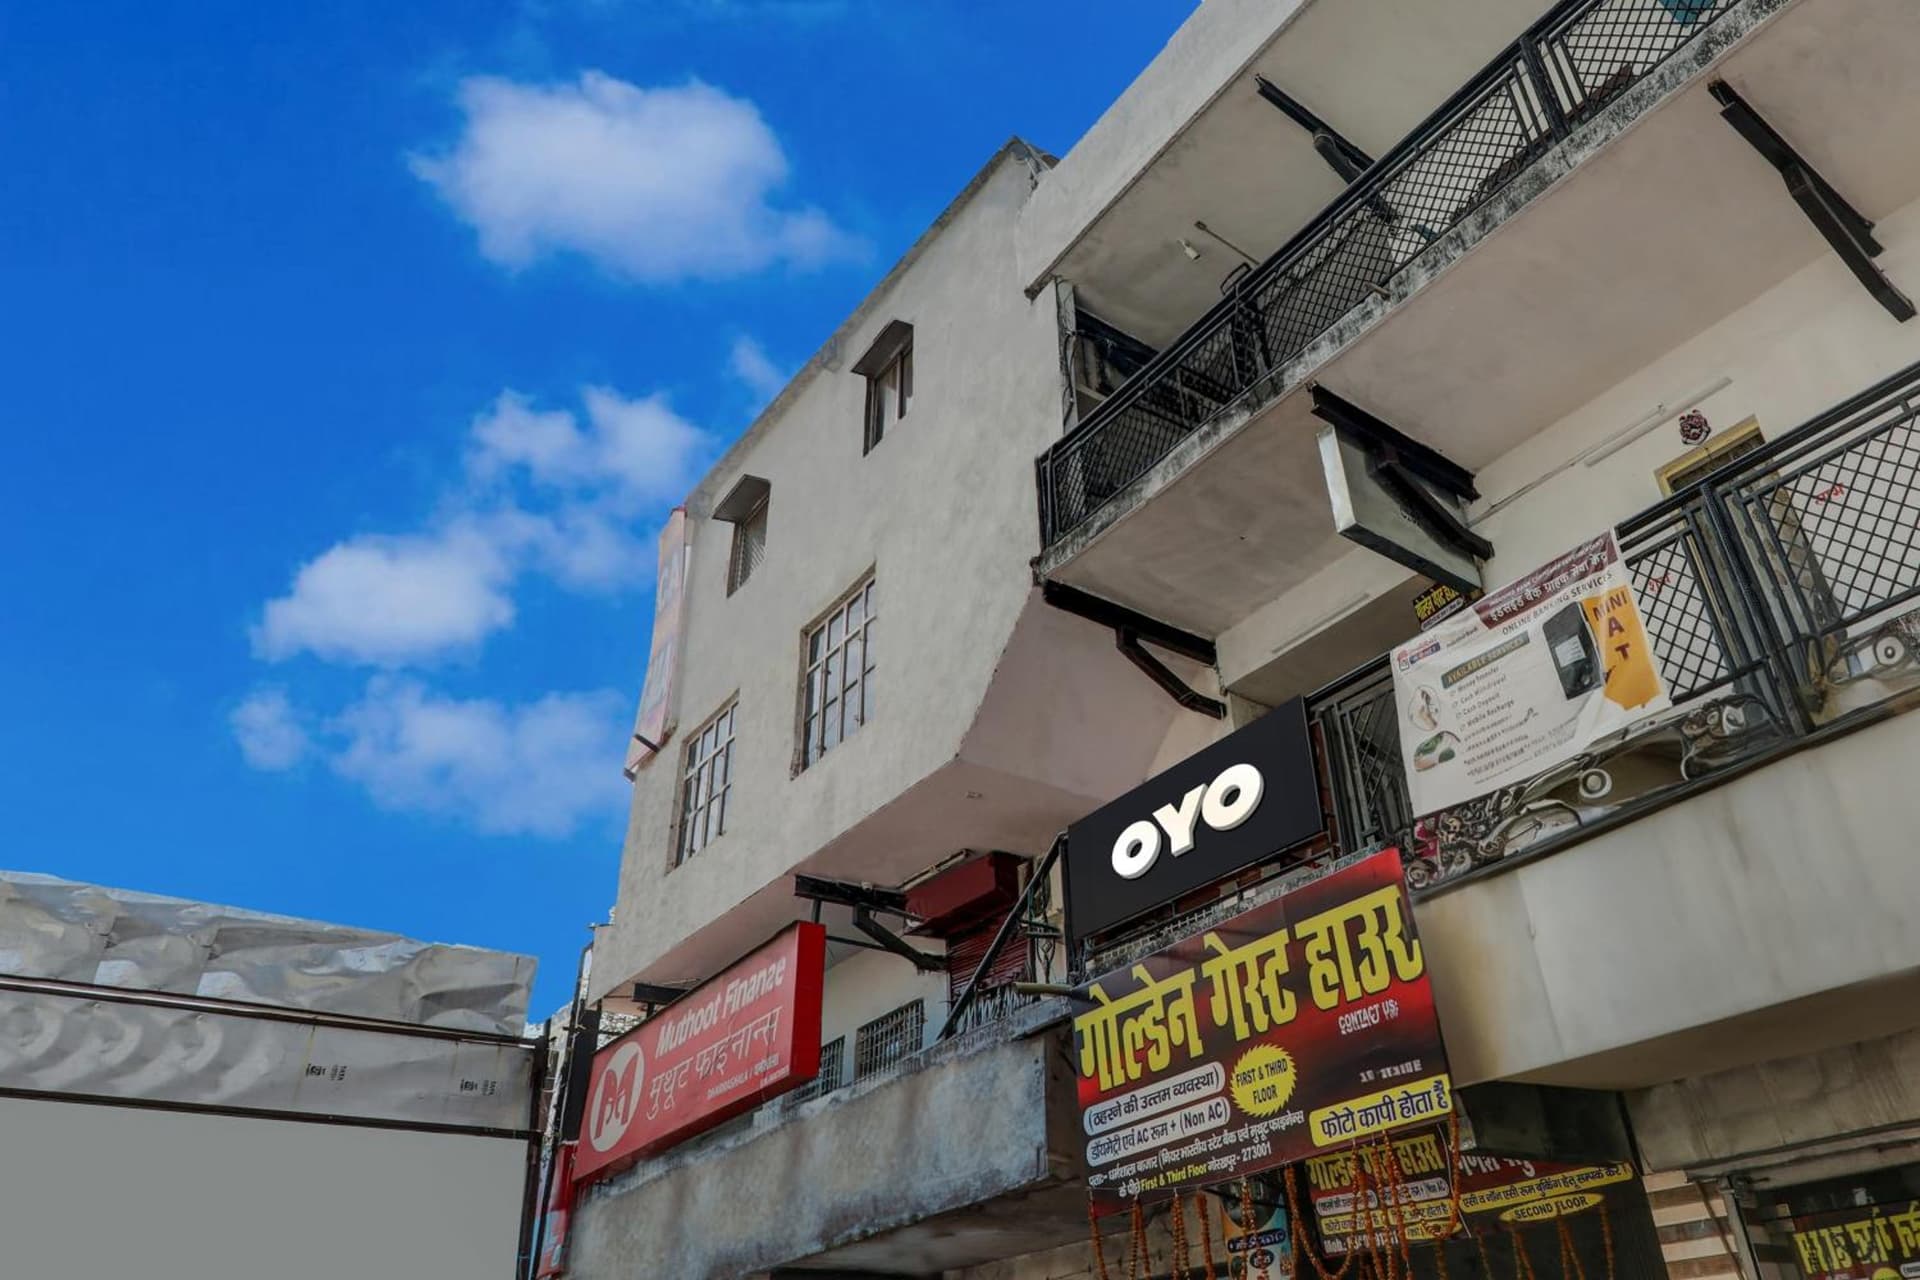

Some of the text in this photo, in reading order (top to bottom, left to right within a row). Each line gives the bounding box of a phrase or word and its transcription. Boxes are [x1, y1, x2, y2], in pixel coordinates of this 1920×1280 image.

[1502, 613, 1532, 636] ONLINE
[1570, 570, 1612, 598] SERVICES
[1592, 591, 1628, 621] MINI
[1111, 763, 1264, 880] OYO
[655, 993, 722, 1059] Muthoot
[1073, 963, 1204, 1092] गोल्डेन
[1201, 928, 1298, 1042] गेस्ट
[1338, 1002, 1381, 1035] CONTACT
[646, 1055, 695, 1121] मुथूट
[1236, 1058, 1288, 1088] FIRST & THIRD
[1253, 1084, 1278, 1105] FLOOR
[1123, 1094, 1139, 1116] की
[1123, 1128, 1136, 1150] एवं
[1137, 1129, 1150, 1144] AC
[1151, 1122, 1169, 1140] रूम
[1180, 1110, 1206, 1136] (Non
[1207, 1097, 1228, 1126] AC)
[1321, 1080, 1449, 1138] फोटो कापी होता है
[1140, 1176, 1159, 1194] First
[1159, 1173, 1165, 1187] &
[1166, 1163, 1187, 1183] Third
[1187, 1161, 1209, 1178] Floor
[1241, 1141, 1272, 1162] 273001
[1514, 1196, 1588, 1219] SECOND FLOOR
